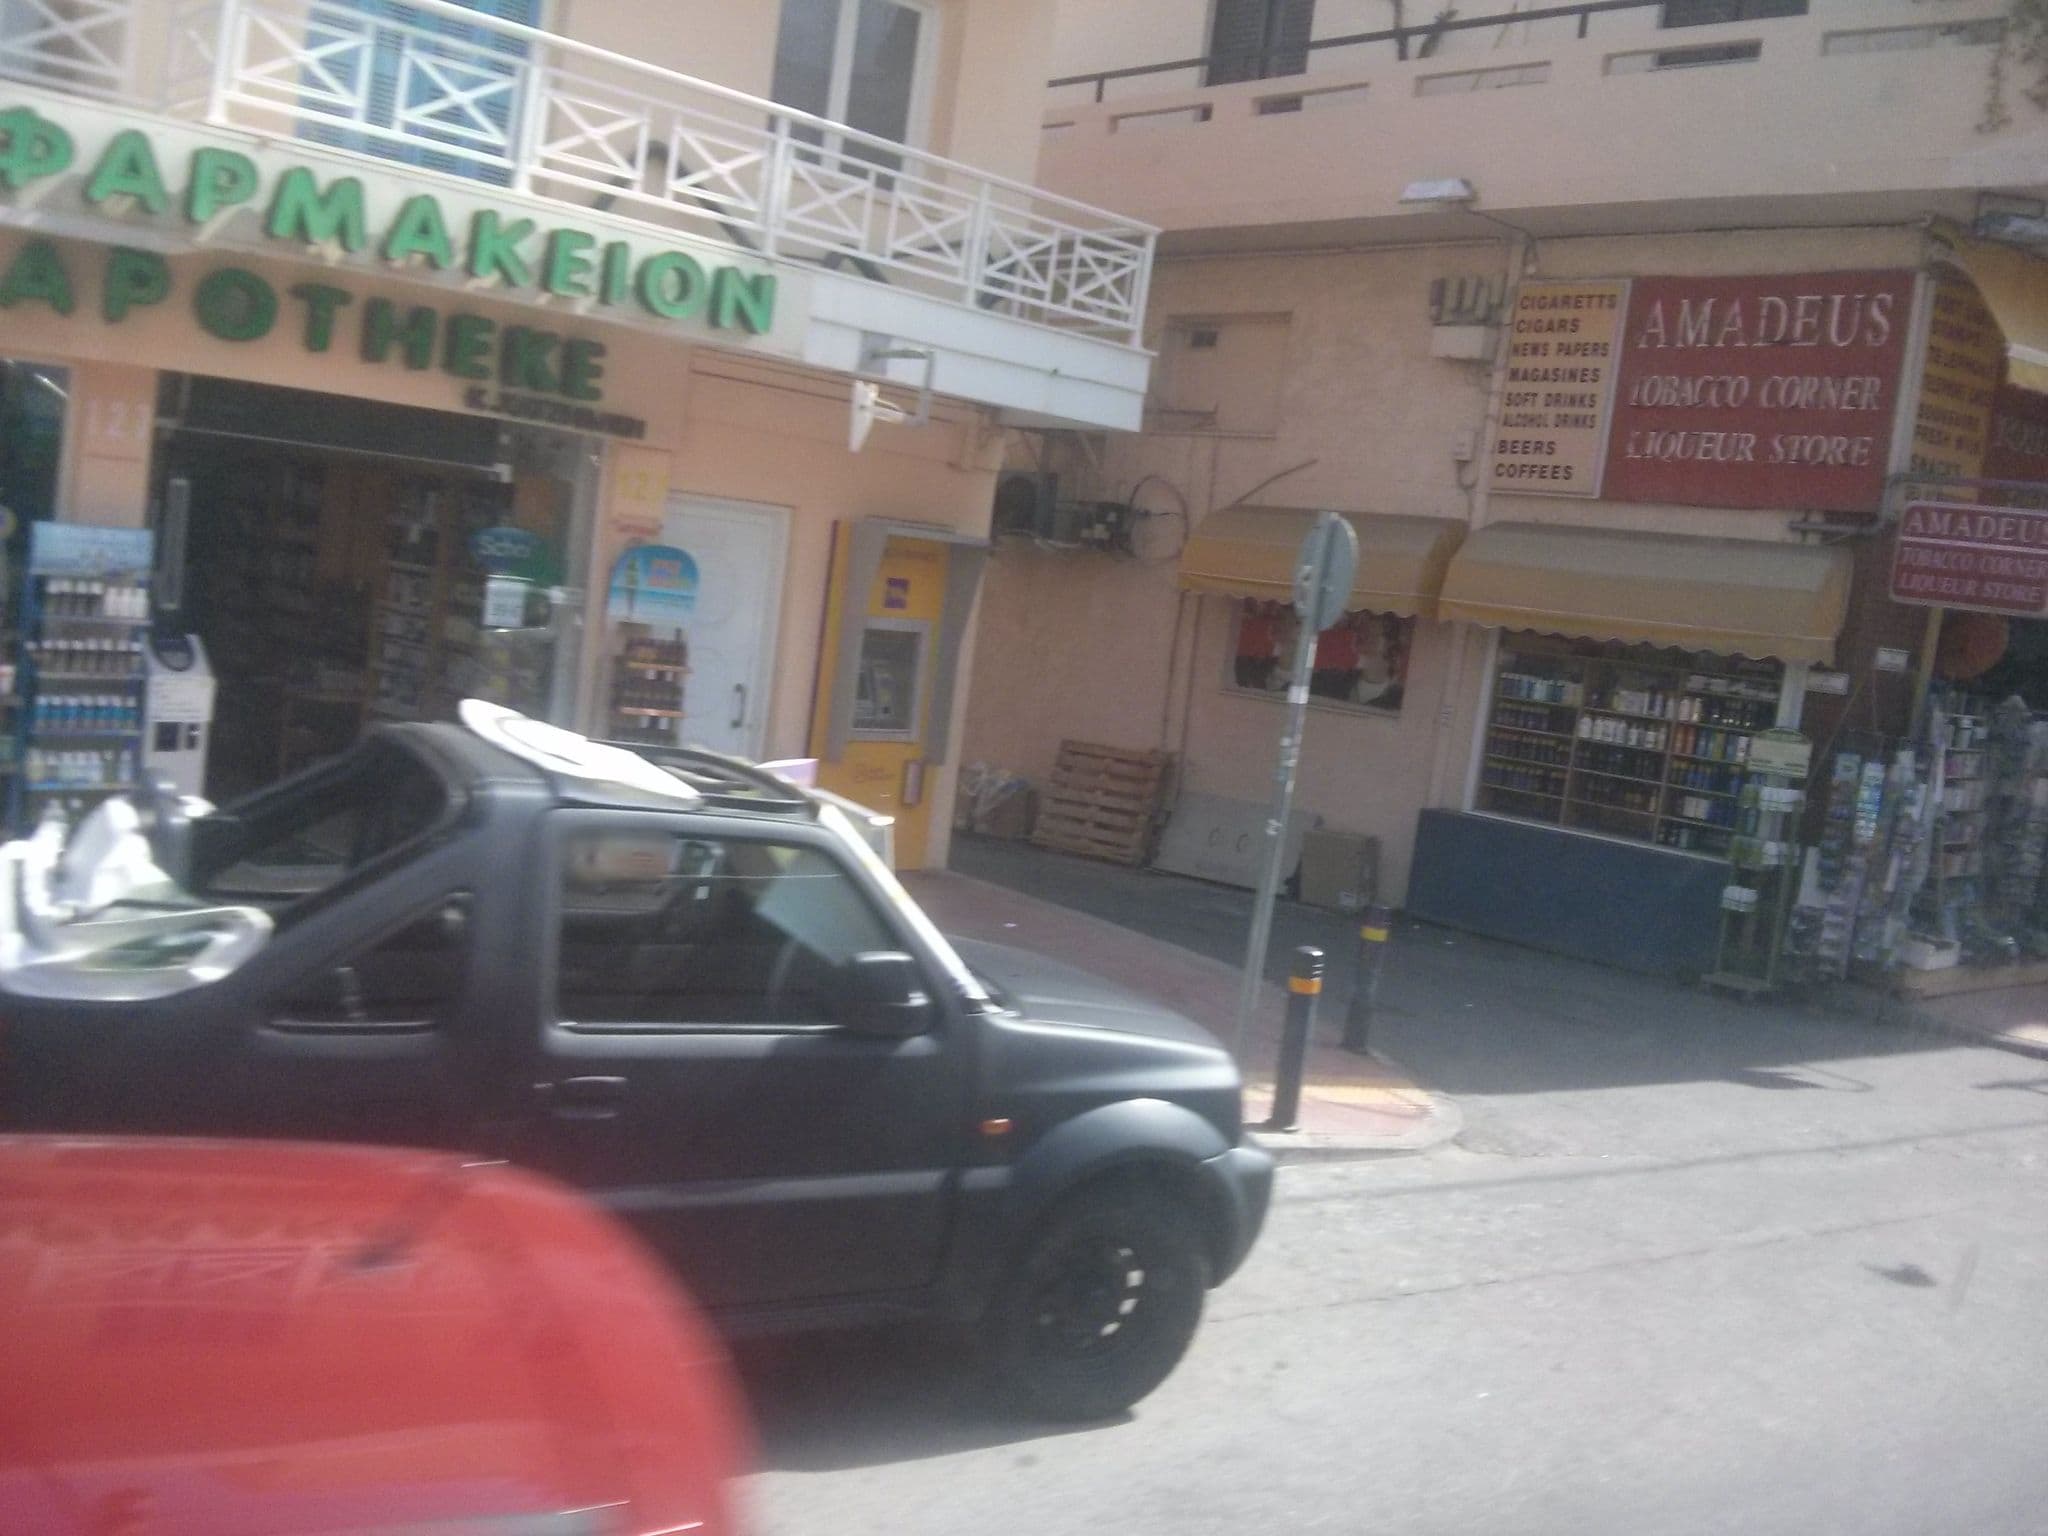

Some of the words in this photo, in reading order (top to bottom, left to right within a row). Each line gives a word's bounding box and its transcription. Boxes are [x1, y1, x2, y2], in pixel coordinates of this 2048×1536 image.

[1519, 294, 1617, 310] CIGARETTS
[0, 240, 607, 399] APOTHEKE
[1516, 318, 1581, 334] CIGARS
[1637, 293, 1896, 349] AMADEUS
[1511, 342, 1550, 357] NEWS
[1556, 342, 1609, 357] PAPERS
[1508, 367, 1601, 383] MAGASINES
[1504, 391, 1539, 408] SOFT
[1544, 392, 1598, 409] DRINKS
[1629, 375, 1750, 408] TOBACCO
[1759, 375, 1882, 410] CORNER
[1553, 413, 1597, 429] DRINKS
[1497, 439, 1557, 456] BEERS
[1626, 431, 1757, 463] LIQUEUR
[1767, 434, 1874, 466] STORE
[1495, 462, 1575, 480] COFFEES
